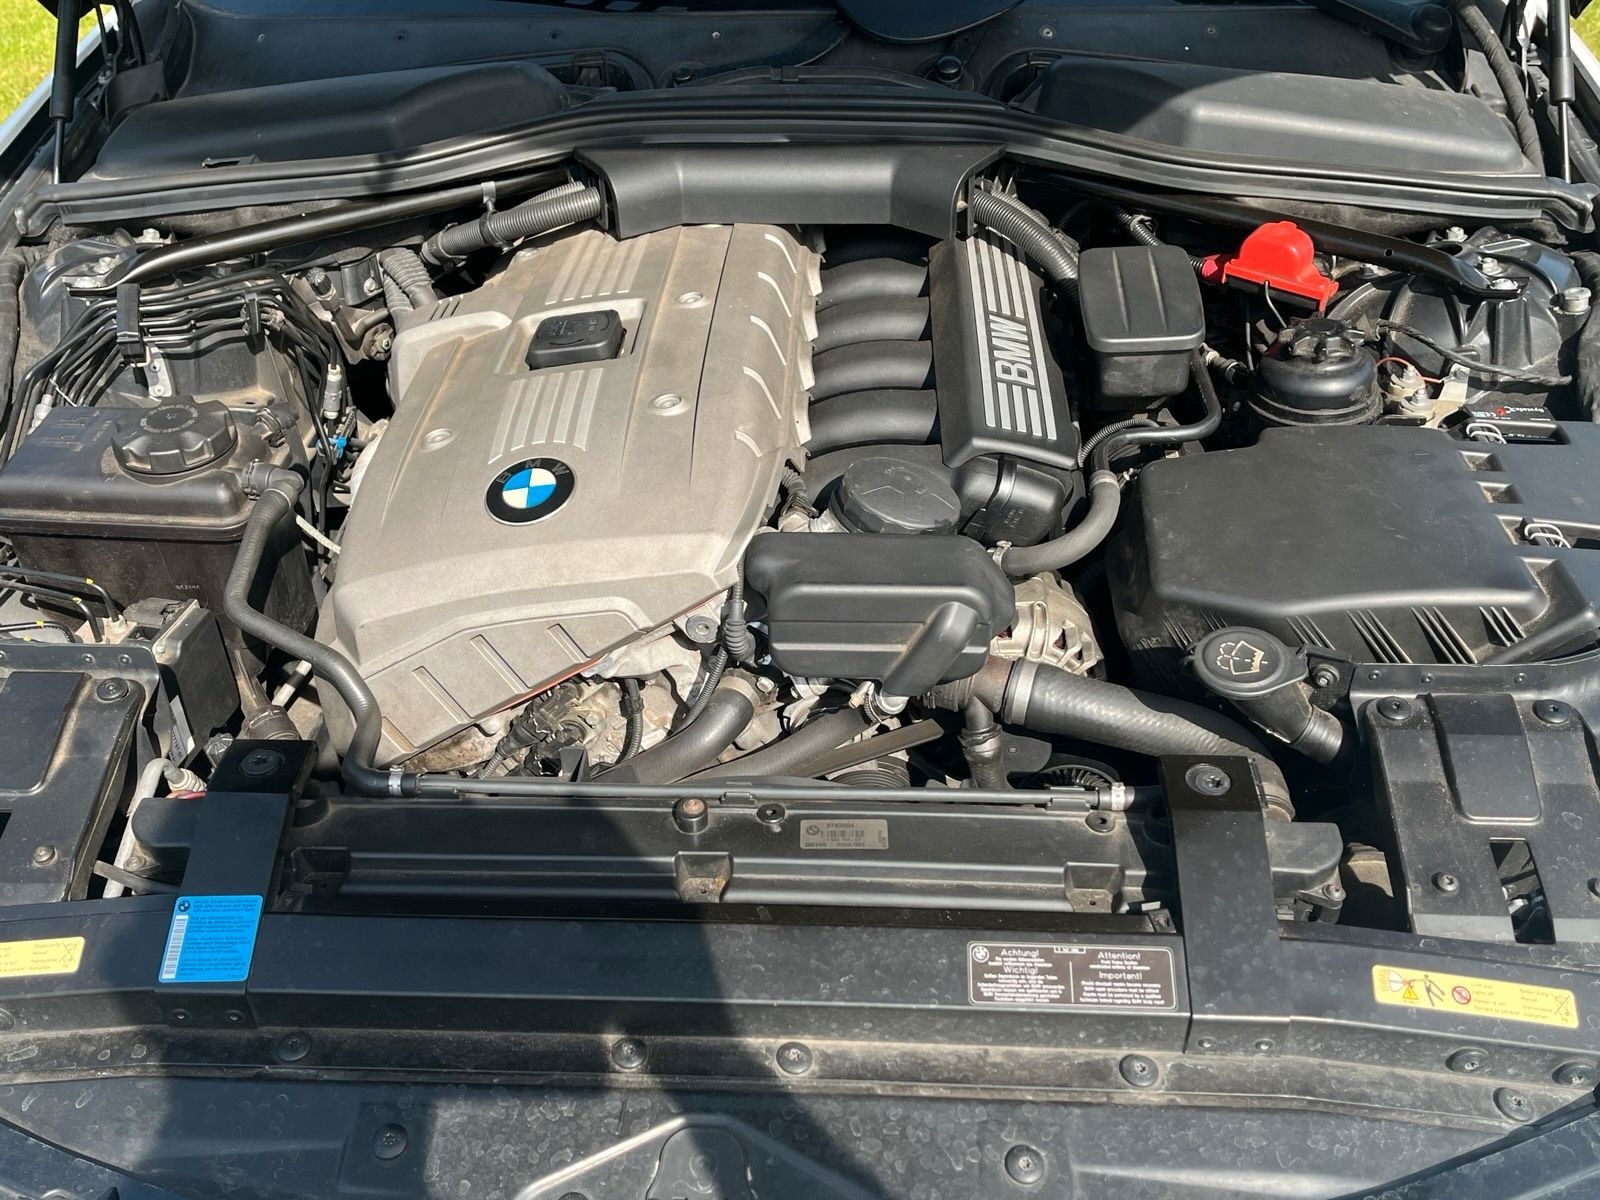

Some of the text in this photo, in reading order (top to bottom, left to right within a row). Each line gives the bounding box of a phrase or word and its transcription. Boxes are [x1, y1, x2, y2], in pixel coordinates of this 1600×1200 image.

[989, 314, 1036, 385] BMW
[495, 459, 570, 484] BMW
[1000, 948, 1039, 958] Achtung!
[1097, 951, 1141, 960] Attention!
[1003, 966, 1039, 975] Wichtig!
[1099, 971, 1143, 981] Important!
